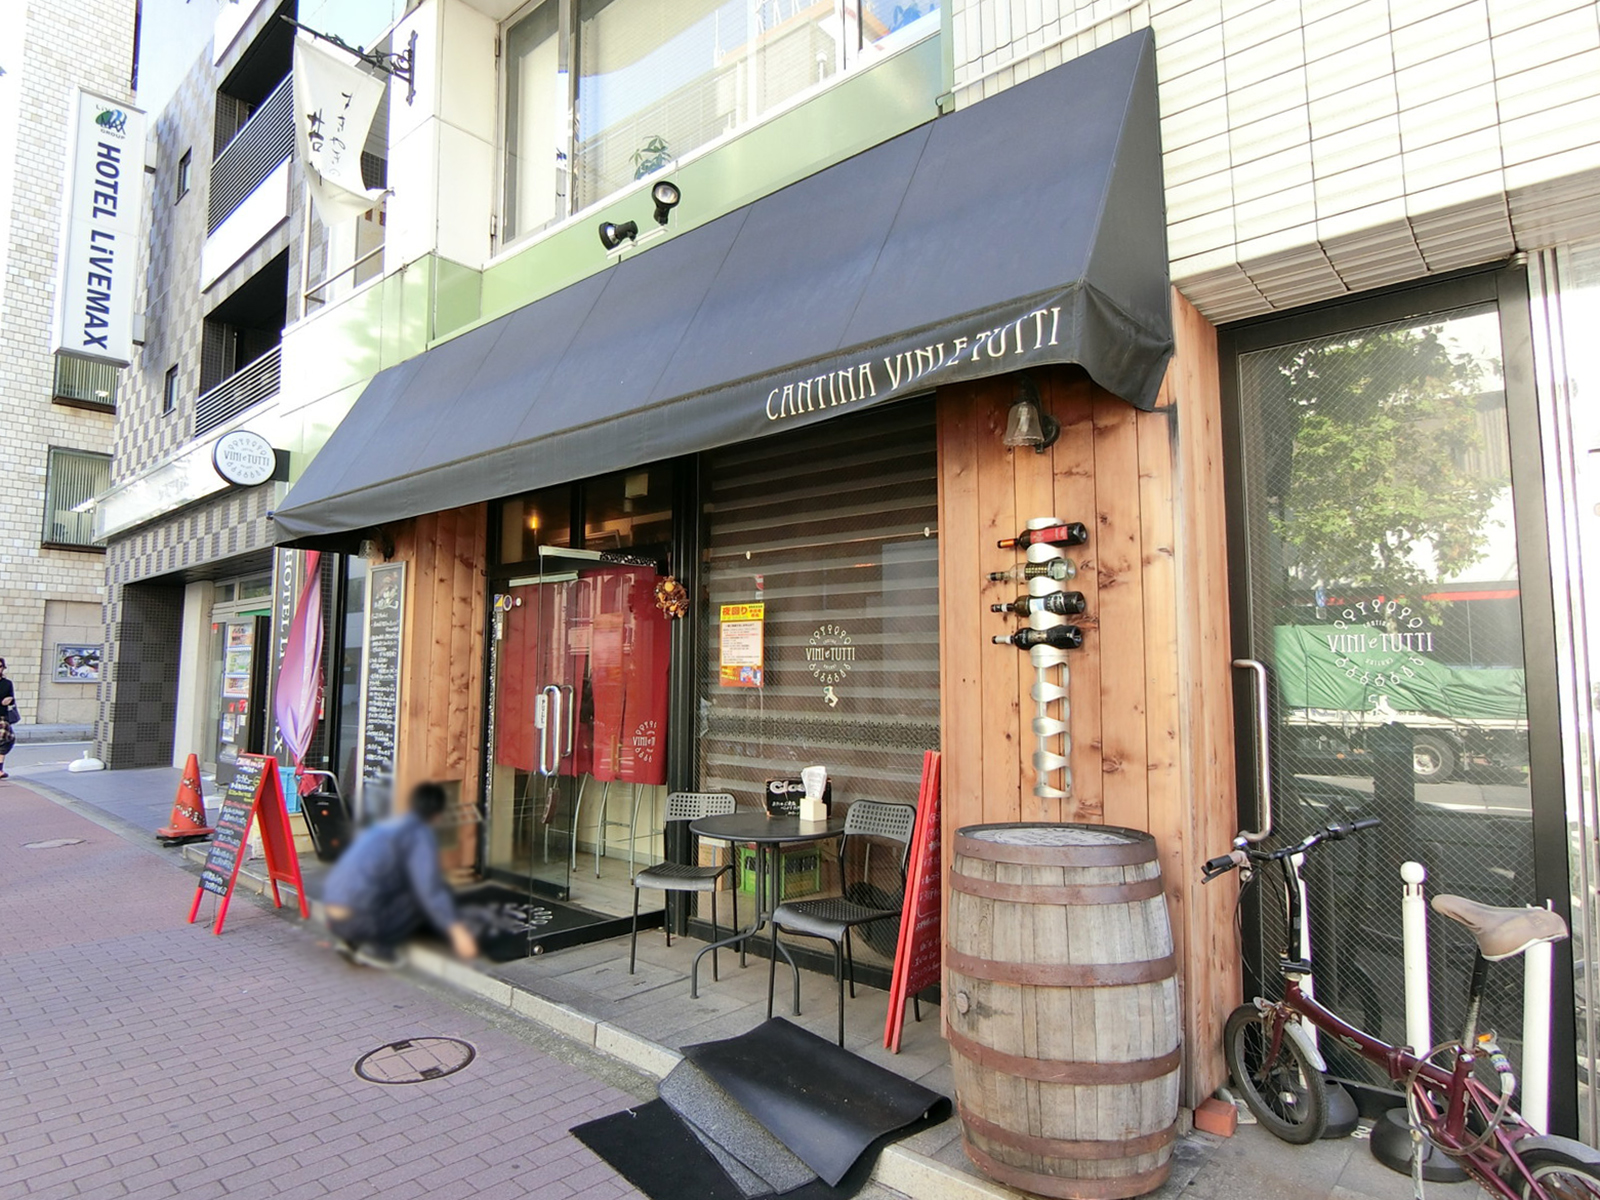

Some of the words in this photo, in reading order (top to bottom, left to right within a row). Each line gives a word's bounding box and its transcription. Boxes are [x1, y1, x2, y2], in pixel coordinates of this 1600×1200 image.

[92, 141, 121, 219] HOTEL
[766, 362, 876, 420] CANTINA
[884, 342, 944, 391] VINI
[971, 307, 1061, 361] TUTTI
[224, 450, 242, 462] VINI
[247, 454, 270, 466] TUTTI
[1327, 634, 1366, 653] VINI
[1380, 632, 1433, 652] TUTTI
[805, 647, 825, 661] VINI
[830, 647, 855, 661] TUTTI
[632, 736, 648, 746] VINI
[770, 780, 806, 794] Clos
